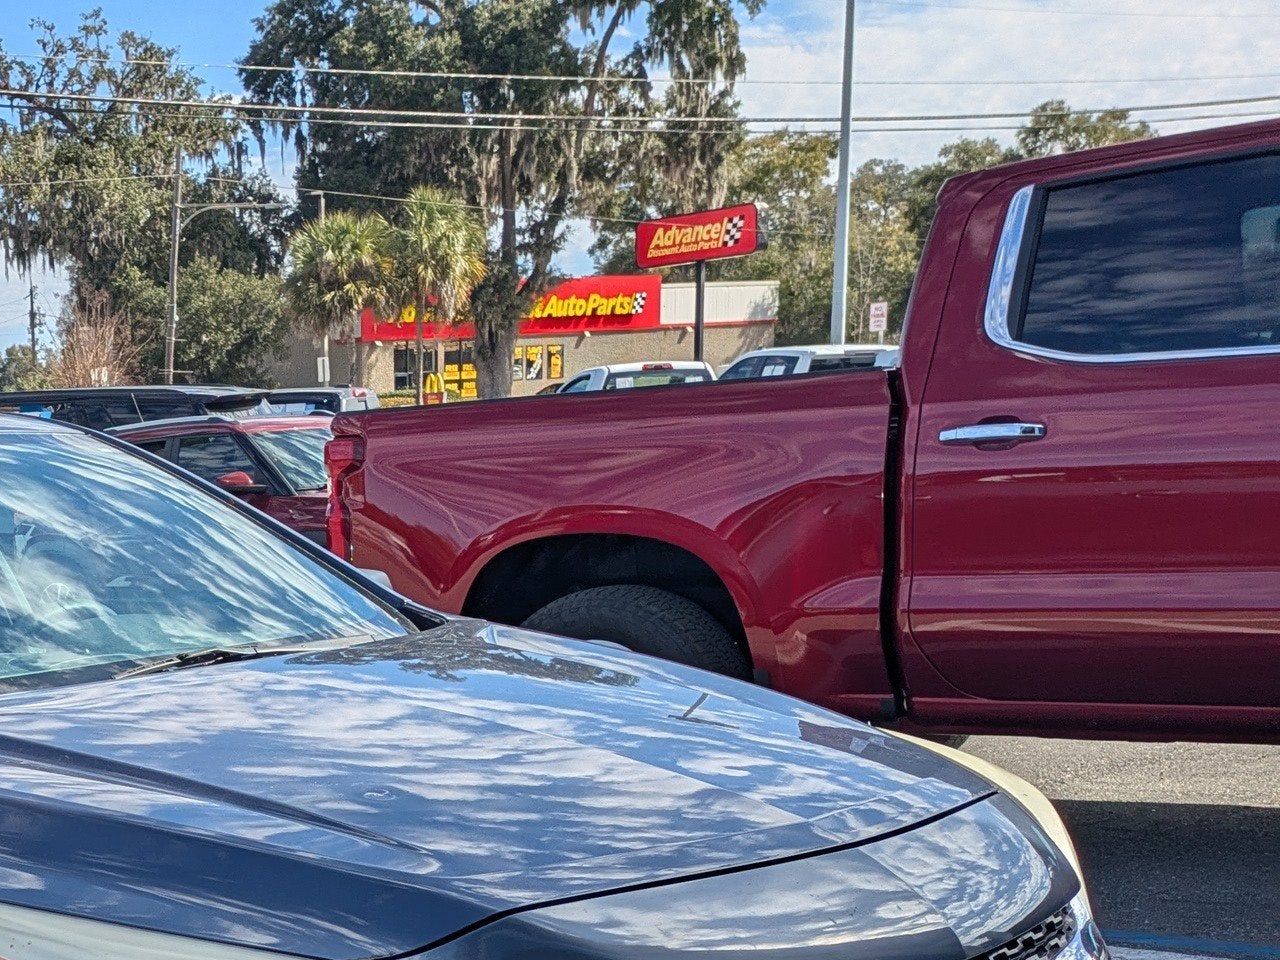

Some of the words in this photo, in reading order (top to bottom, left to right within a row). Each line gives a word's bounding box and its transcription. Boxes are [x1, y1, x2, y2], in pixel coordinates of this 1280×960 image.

[648, 245, 679, 257] Discount
[680, 243, 697, 253] Auto
[698, 240, 719, 250] Parts
[650, 222, 721, 249] Advance
[542, 294, 586, 318] Auto
[586, 292, 631, 316] Parts
